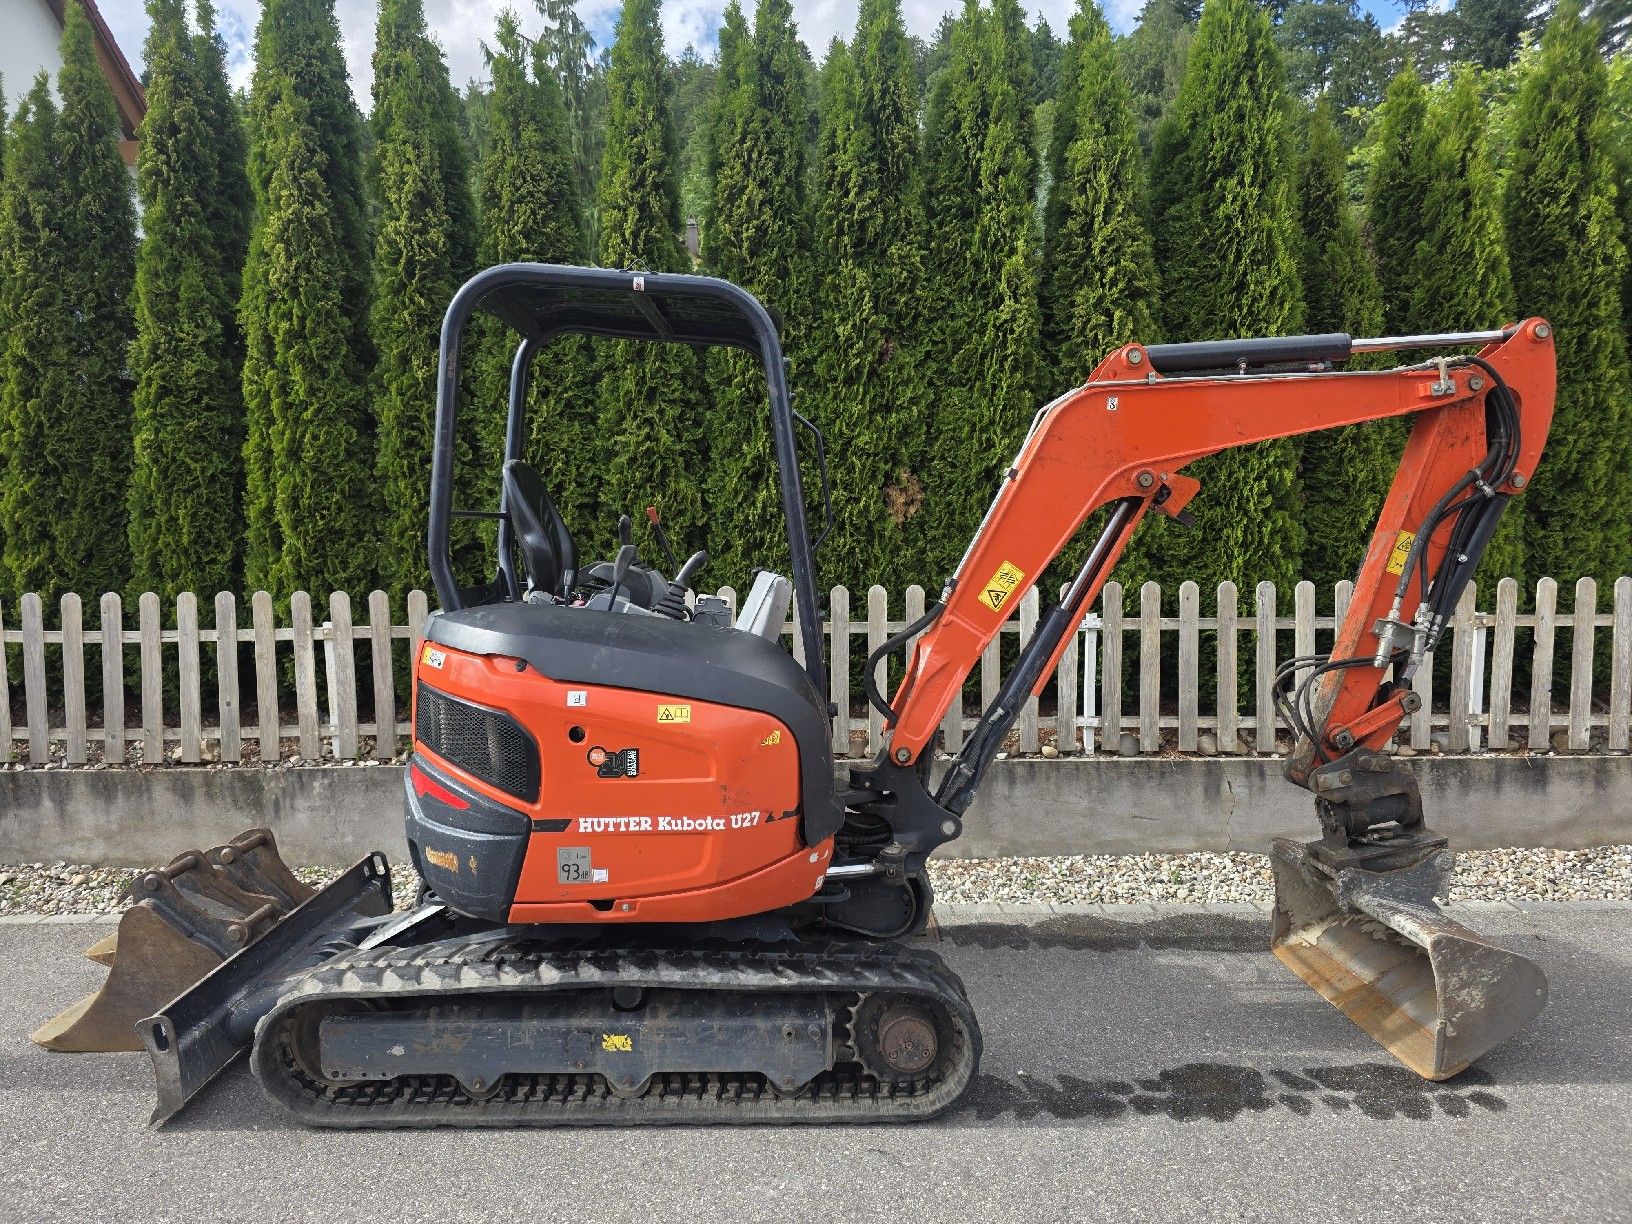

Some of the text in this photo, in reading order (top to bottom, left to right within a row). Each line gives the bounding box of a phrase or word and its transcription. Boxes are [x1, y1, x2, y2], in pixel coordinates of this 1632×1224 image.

[579, 811, 760, 833] HUTTER Kubota U27
[561, 863, 580, 881] 93
